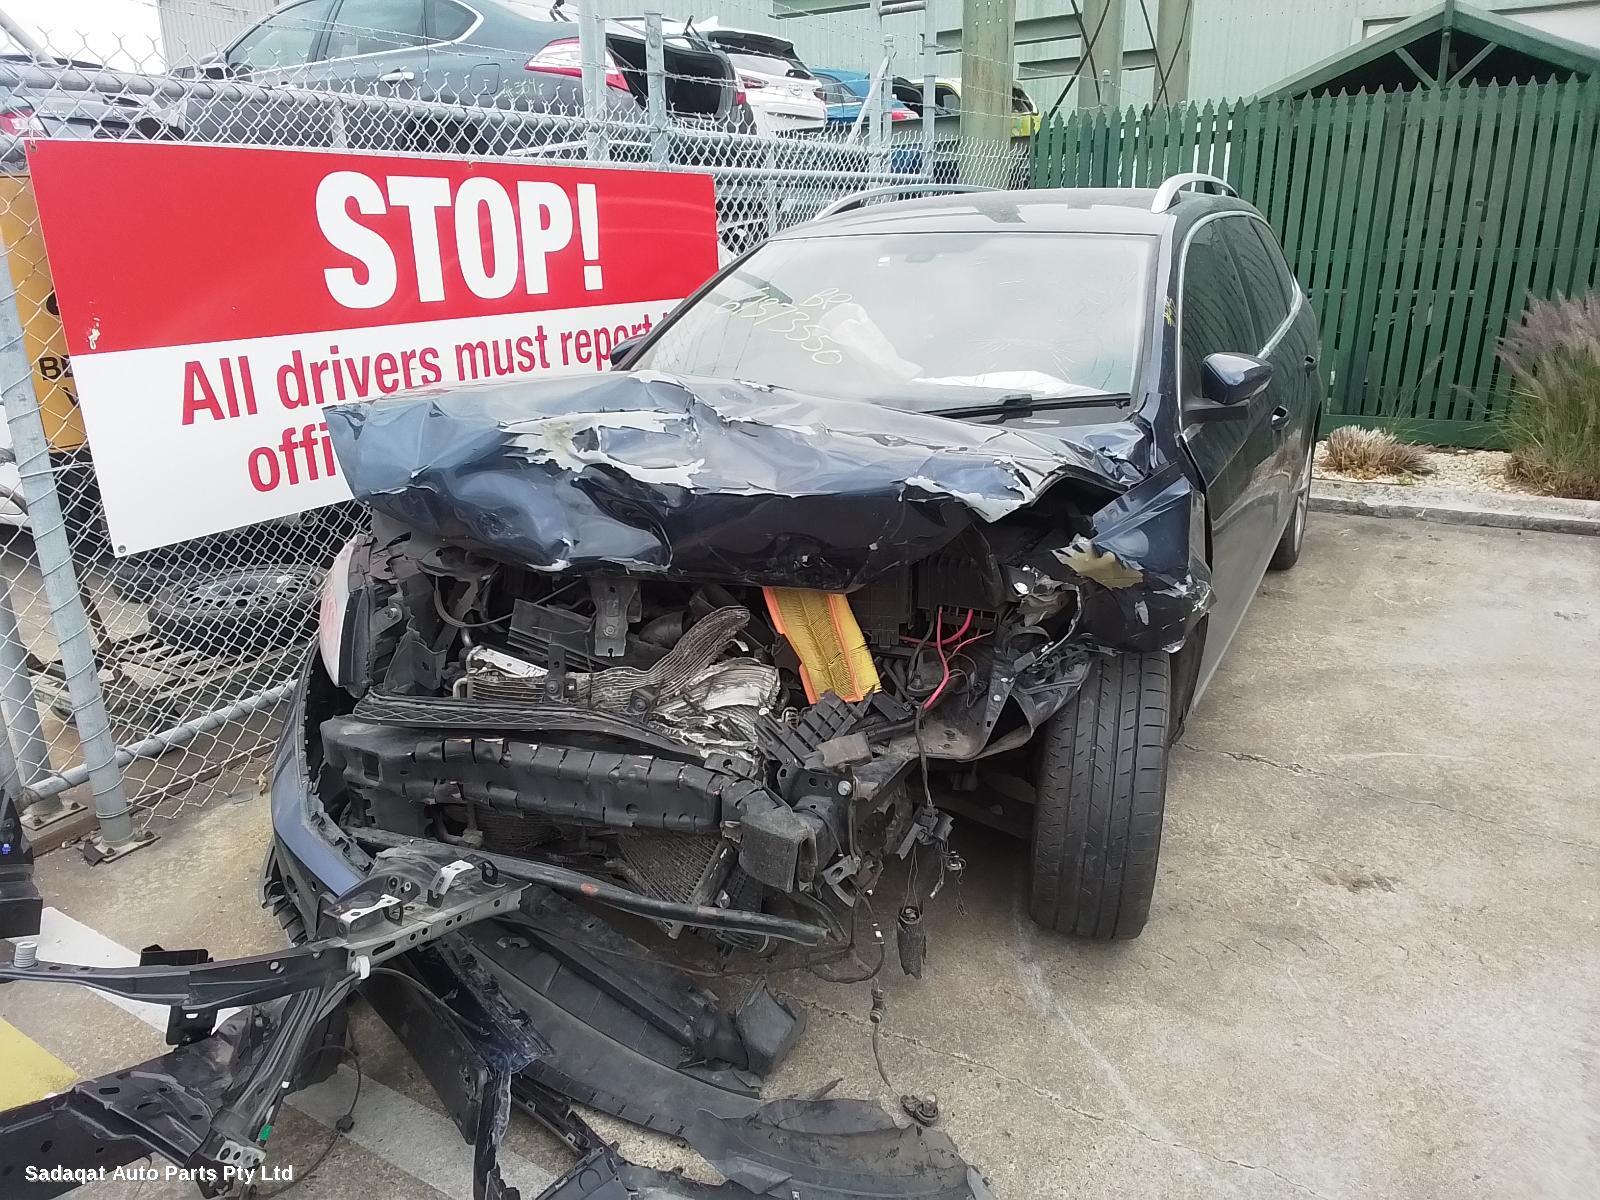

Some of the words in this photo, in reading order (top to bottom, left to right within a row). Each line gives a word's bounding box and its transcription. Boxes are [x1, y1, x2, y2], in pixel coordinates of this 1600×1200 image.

[315, 170, 604, 309] STOP!
[181, 355, 258, 426] All
[276, 345, 442, 409] drivers
[454, 325, 551, 382] must
